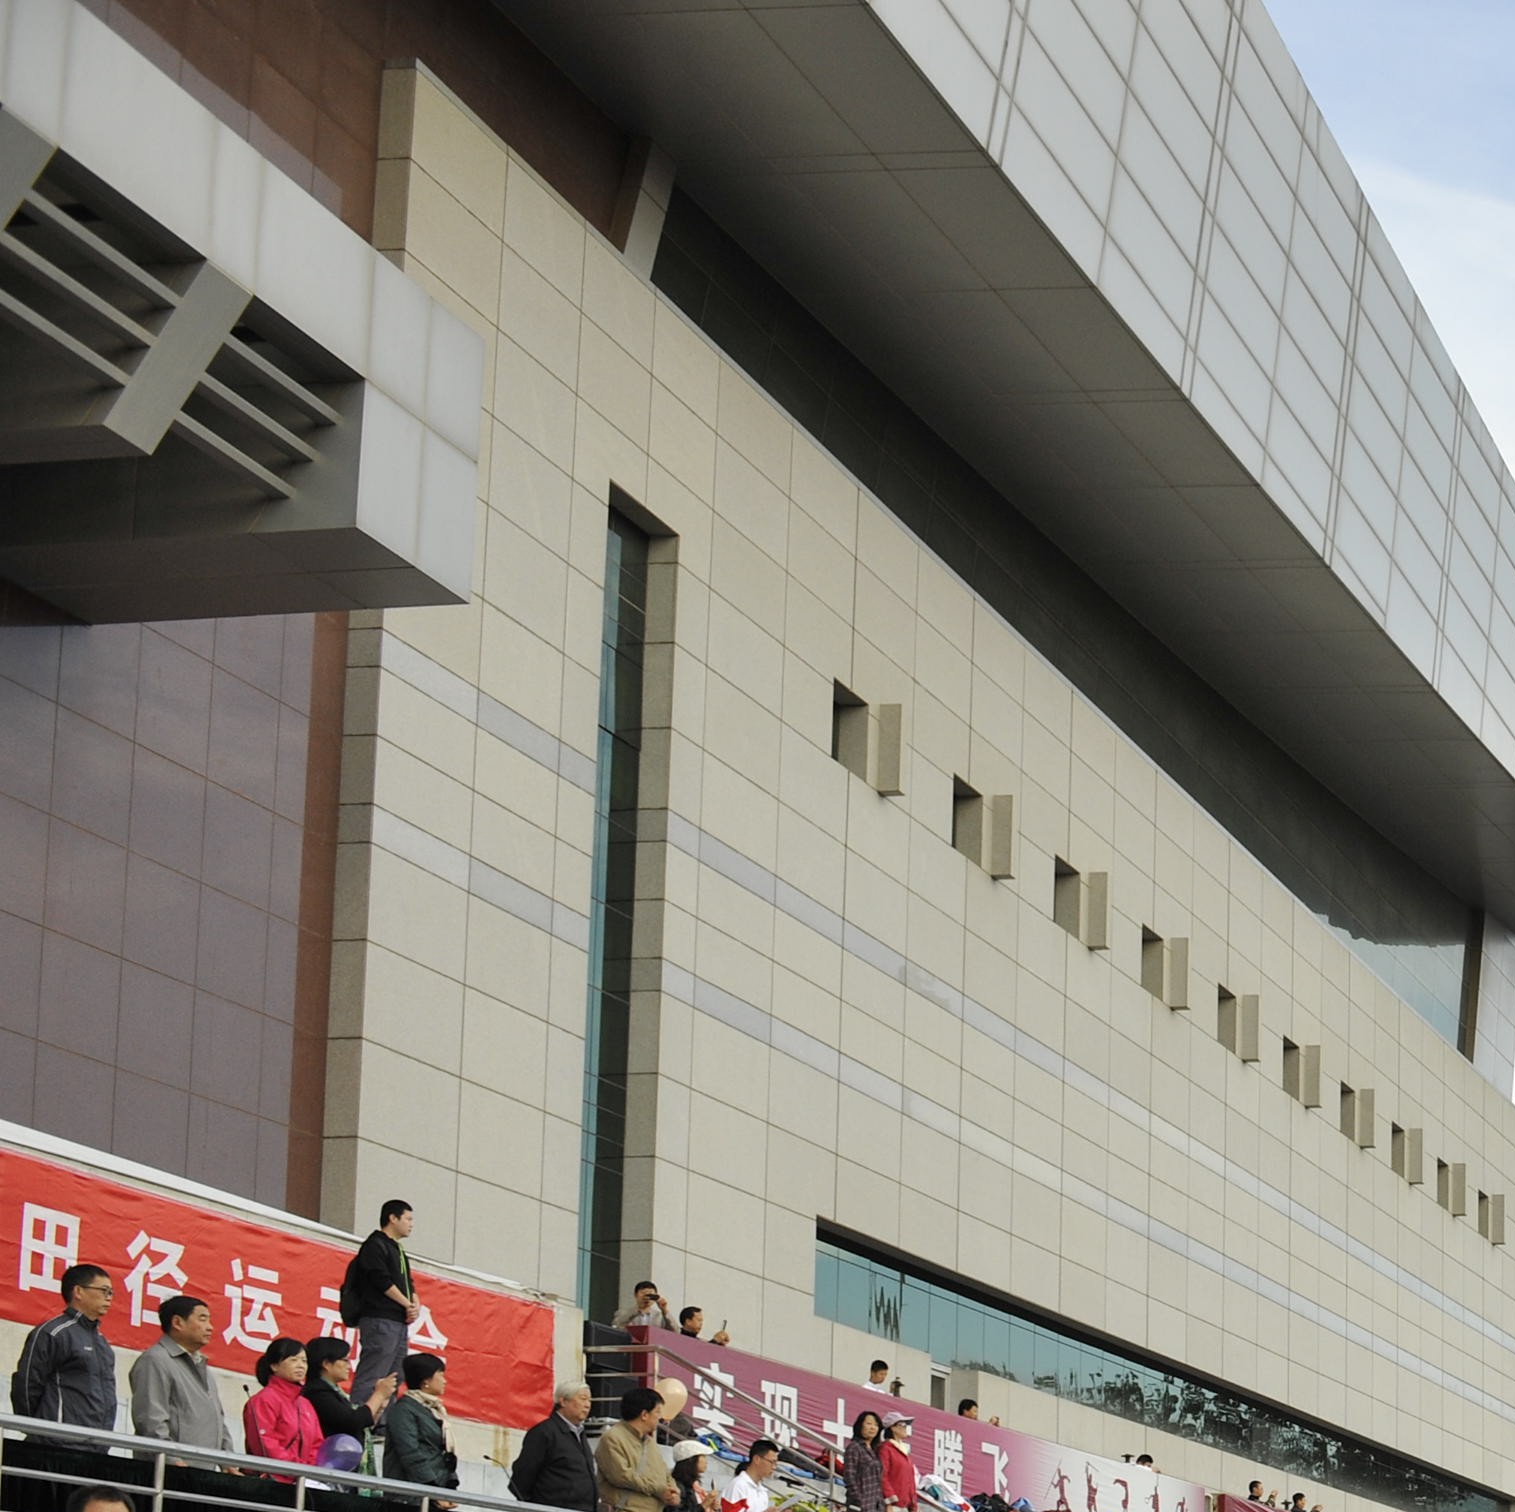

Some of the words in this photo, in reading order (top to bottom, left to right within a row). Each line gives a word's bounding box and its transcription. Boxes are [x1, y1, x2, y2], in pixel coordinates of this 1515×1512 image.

[692, 1362, 1010, 1504] 实现十腾飞
